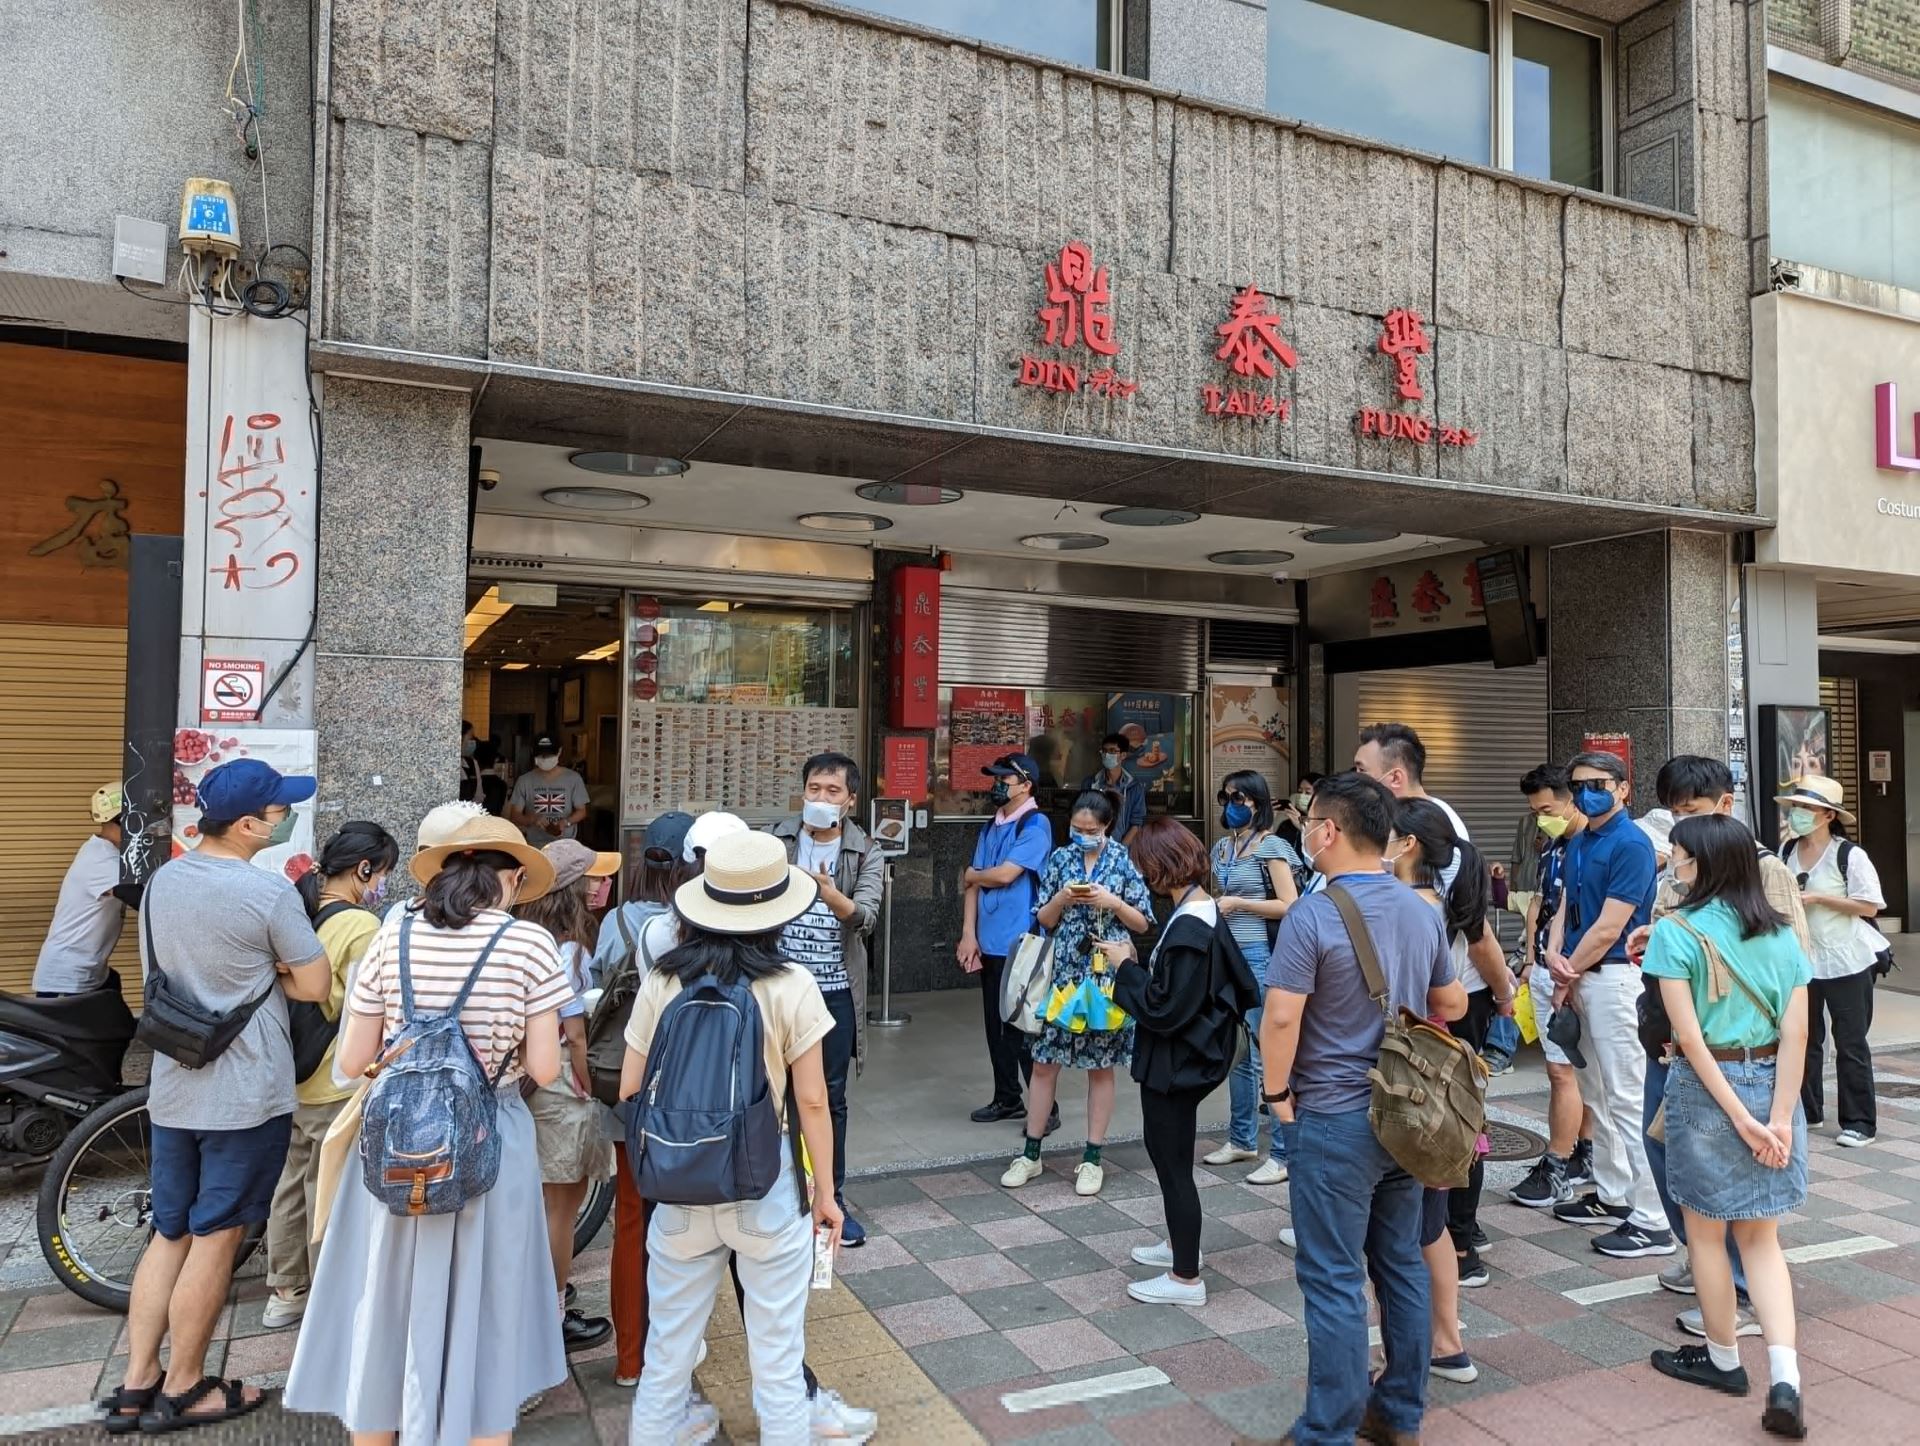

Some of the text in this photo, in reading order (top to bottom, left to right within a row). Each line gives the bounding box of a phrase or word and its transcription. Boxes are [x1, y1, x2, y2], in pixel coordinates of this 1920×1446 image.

[1019, 357, 1078, 392] DIN
[1203, 385, 1258, 416] TAI
[1359, 408, 1431, 444] FUNG
[912, 592, 933, 698] 鼎泰豐
[209, 661, 260, 671] NO SMOKING
[51, 1235, 91, 1284] MAXXIS
